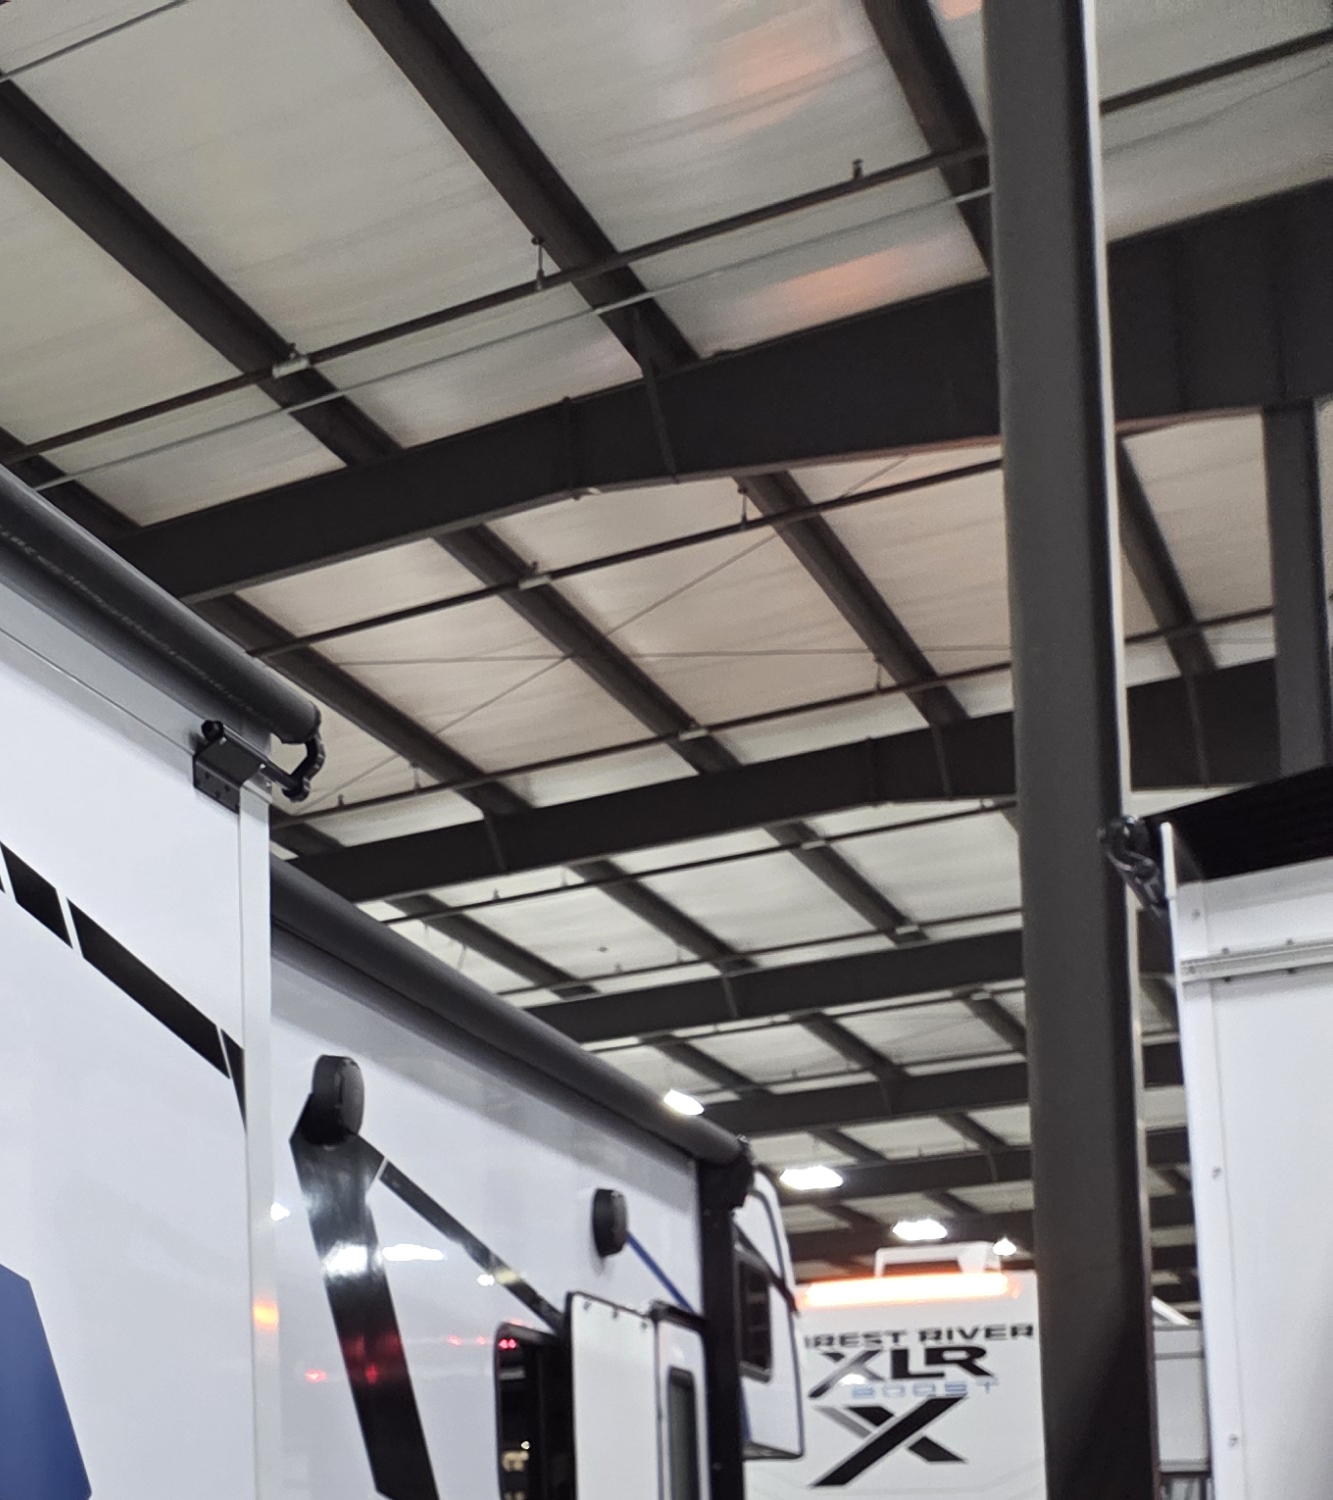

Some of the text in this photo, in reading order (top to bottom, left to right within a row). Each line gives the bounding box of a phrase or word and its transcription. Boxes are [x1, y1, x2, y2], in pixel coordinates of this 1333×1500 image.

[805, 1323, 1034, 1347] REST RIVER
[808, 1346, 995, 1398] XLR
